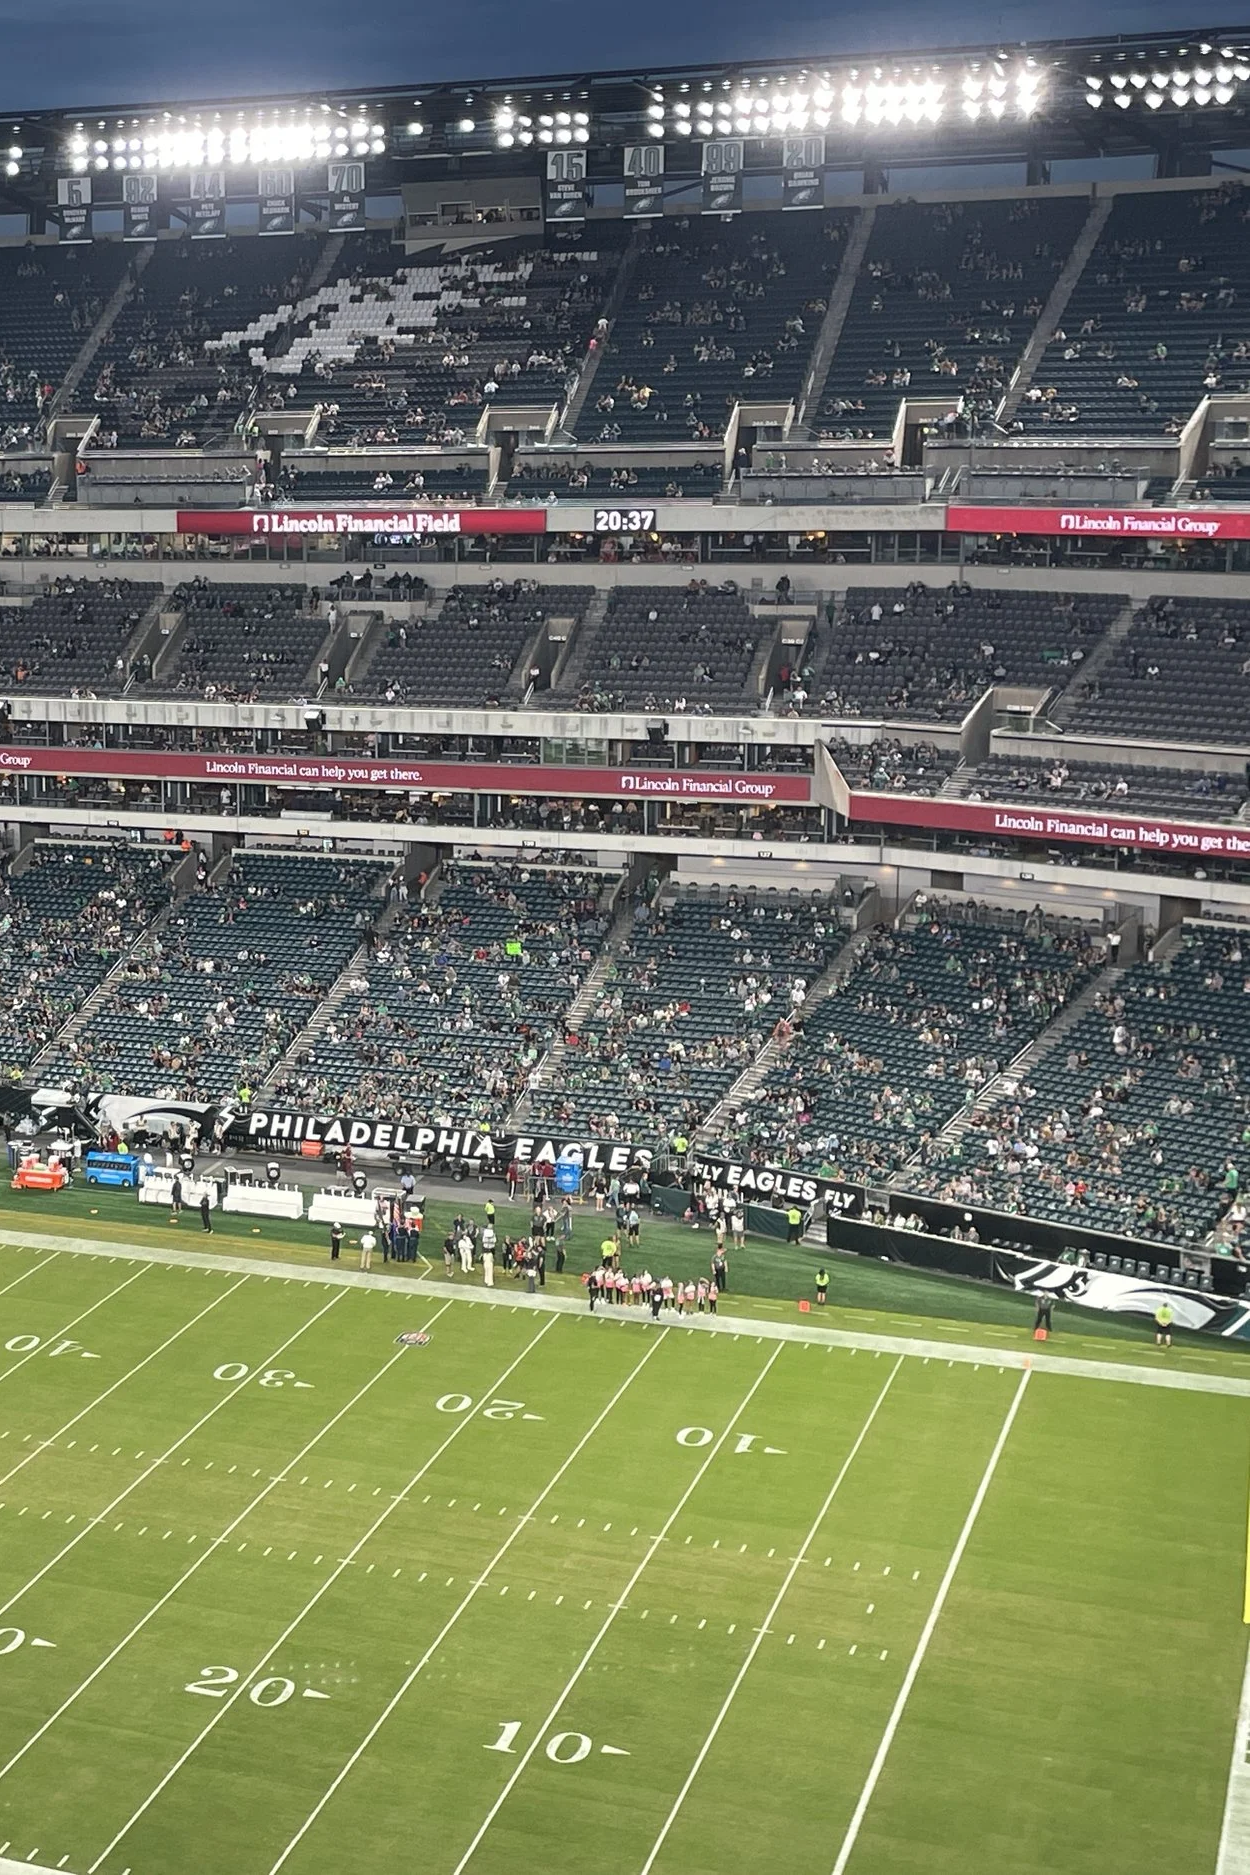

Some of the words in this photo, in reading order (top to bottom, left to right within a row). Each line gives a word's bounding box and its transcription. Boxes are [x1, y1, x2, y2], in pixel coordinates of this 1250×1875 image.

[550, 152, 584, 182] 15
[628, 147, 660, 178] 40
[331, 165, 362, 194] 70
[67, 180, 82, 207] 5
[271, 514, 334, 532] Lincoln
[336, 513, 414, 533] Financial
[416, 513, 461, 533] Field
[596, 511, 654, 531] 20:37
[1075, 515, 1121, 530] Lincoln
[1124, 516, 1175, 531] Financial
[1177, 518, 1220, 536] Group
[0, 753, 32, 768] Group
[206, 762, 245, 773] Lincoln
[248, 763, 297, 775] Financial
[299, 767, 319, 776] can
[321, 765, 346, 780] help
[348, 769, 369, 780] you
[370, 769, 387, 781] get
[390, 768, 422, 780] there.
[635, 777, 679, 791] Lincoln
[683, 779, 732, 792] Financial
[735, 780, 773, 798] Group
[995, 814, 1043, 831] Lincoln
[1047, 818, 1108, 838] Financial
[1111, 828, 1135, 840] can
[1139, 827, 1169, 846] help
[1172, 834, 1198, 848] you
[1201, 837, 1223, 851] get
[249, 1112, 496, 1159] PHILADELPHIA
[727, 1165, 817, 1201] EAGLES
[824, 1189, 856, 1209] FLY
[4, 1335, 84, 1357] 40
[213, 1362, 295, 1388] 30
[435, 1393, 526, 1420] 20
[676, 1426, 765, 1454] 10
[185, 1665, 295, 1707] 20
[483, 1720, 592, 1763] 10
